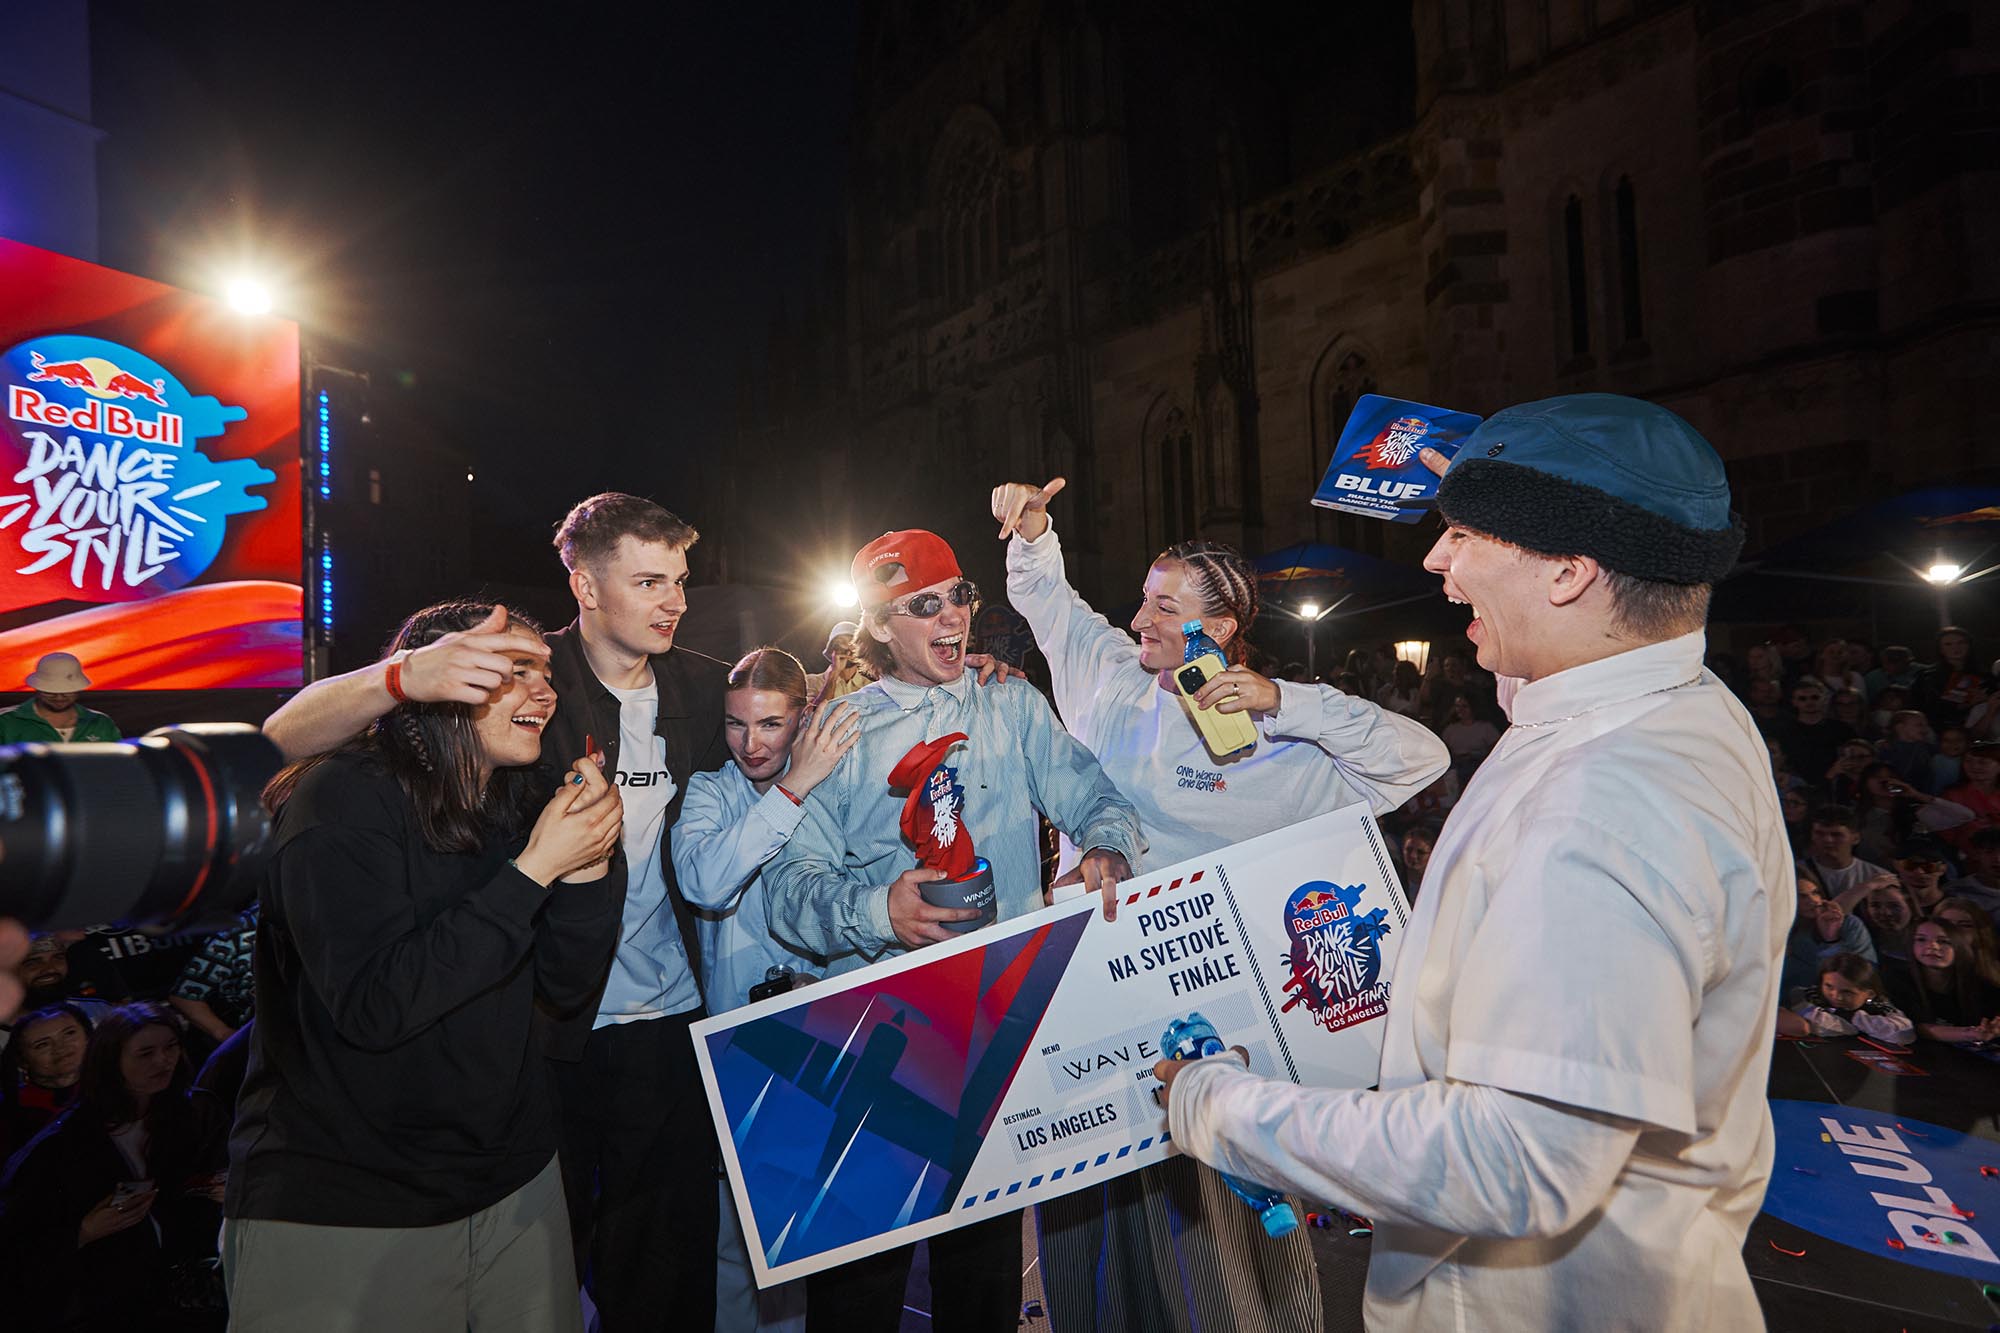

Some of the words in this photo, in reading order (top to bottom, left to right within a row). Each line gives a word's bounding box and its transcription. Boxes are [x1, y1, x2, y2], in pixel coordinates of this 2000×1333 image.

[11, 387, 100, 433] Red
[106, 402, 182, 446] Bull
[1384, 431, 1422, 441] DANCE
[13, 431, 178, 492] DANCE
[1377, 448, 1413, 465] STYLE
[1384, 440, 1416, 452] YOUR
[28, 472, 194, 536] YOUR
[1334, 473, 1426, 498] BLUE
[1338, 497, 1369, 506] DANCE
[1369, 502, 1400, 511] FLOOR
[1347, 493, 1378, 502] RULES
[16, 513, 184, 590] STYLE
[1138, 892, 1215, 937] POSTUP
[1293, 911, 1321, 932] Red
[1321, 903, 1348, 924] Bull
[1108, 954, 1138, 982] NA
[1140, 918, 1229, 970] SVETOVÉ
[1301, 922, 1353, 962] DANCE
[1313, 936, 1370, 979] YOUR
[1168, 953, 1240, 996] FINÁLE
[1318, 956, 1369, 1000] STYLE
[1312, 997, 1357, 1025] WORLD
[1329, 1018, 1346, 1029] LOS
[1347, 1004, 1385, 1023] ANGELES
[1041, 1043, 1061, 1056] MENO
[1063, 1041, 1158, 1080] WAVE
[1135, 1067, 1154, 1081] DÁTU
[1003, 1107, 1042, 1126] DESTINÁCIA
[1017, 1127, 1048, 1151] LOS
[1051, 1103, 1117, 1141] ANGELES
[1820, 1117, 2000, 1264] BLUE
